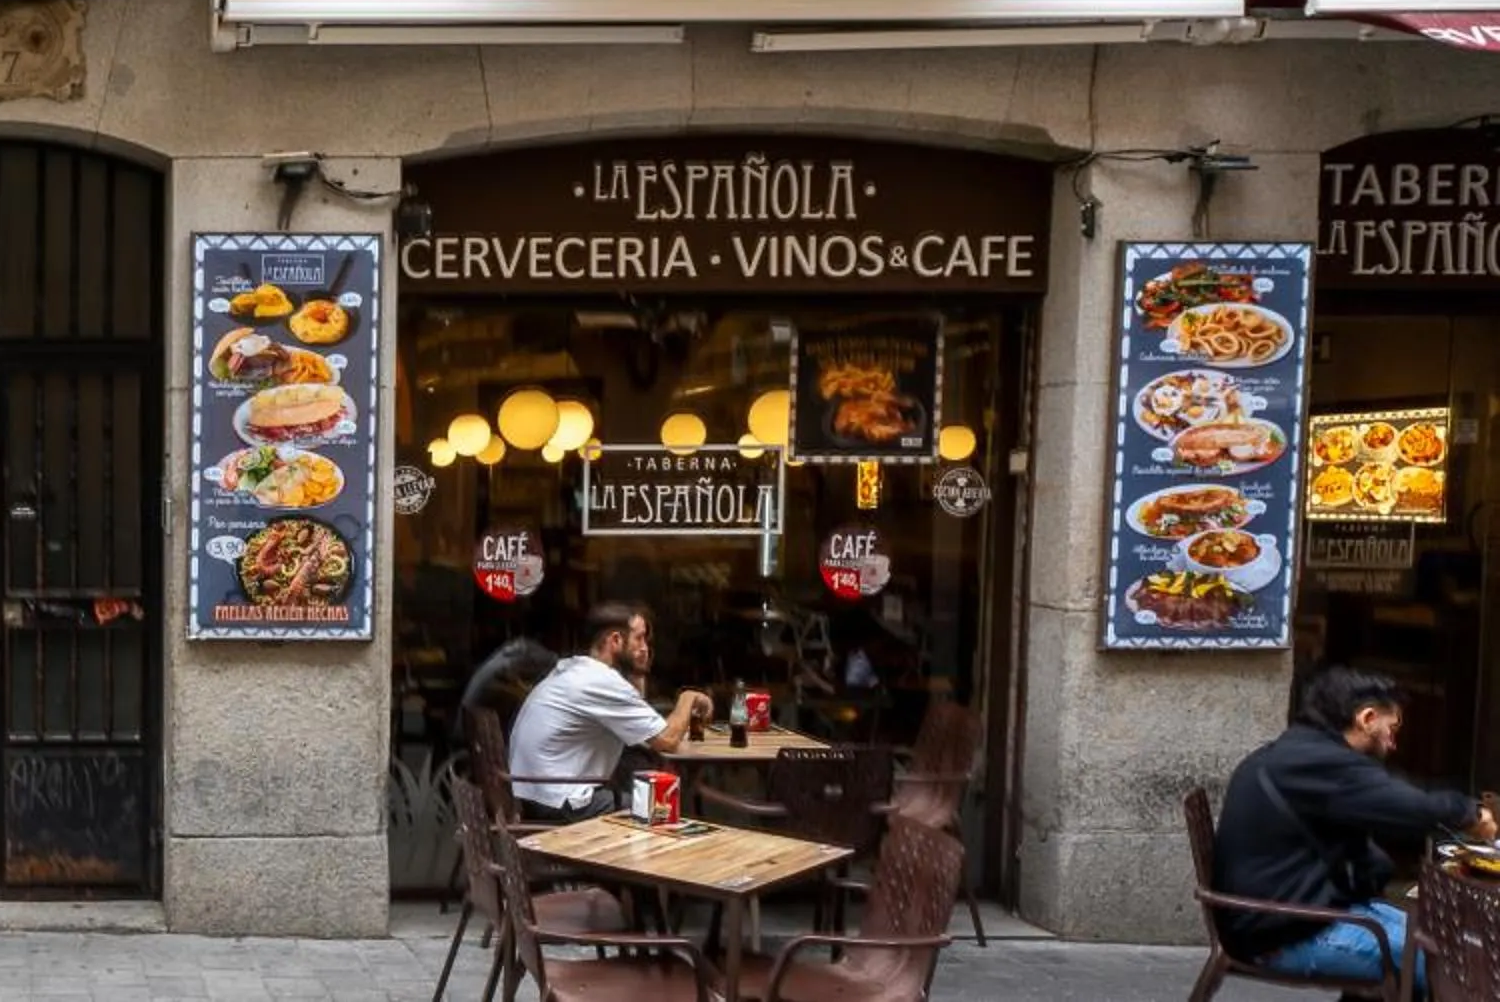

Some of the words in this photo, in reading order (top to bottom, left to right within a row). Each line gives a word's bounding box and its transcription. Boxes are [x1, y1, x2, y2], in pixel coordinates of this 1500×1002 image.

[3, 51, 21, 83] 7
[594, 165, 629, 199] LA
[636, 153, 857, 221] ESPAÑOLA
[1323, 163, 1500, 206] TABER
[401, 236, 697, 280] CERVECERIA
[634, 457, 731, 471] TABERNA
[592, 485, 617, 510] LA
[621, 476, 776, 523] ESPAÑOLA
[483, 532, 529, 561] CAFÉ
[831, 531, 877, 559] CAFÉ
